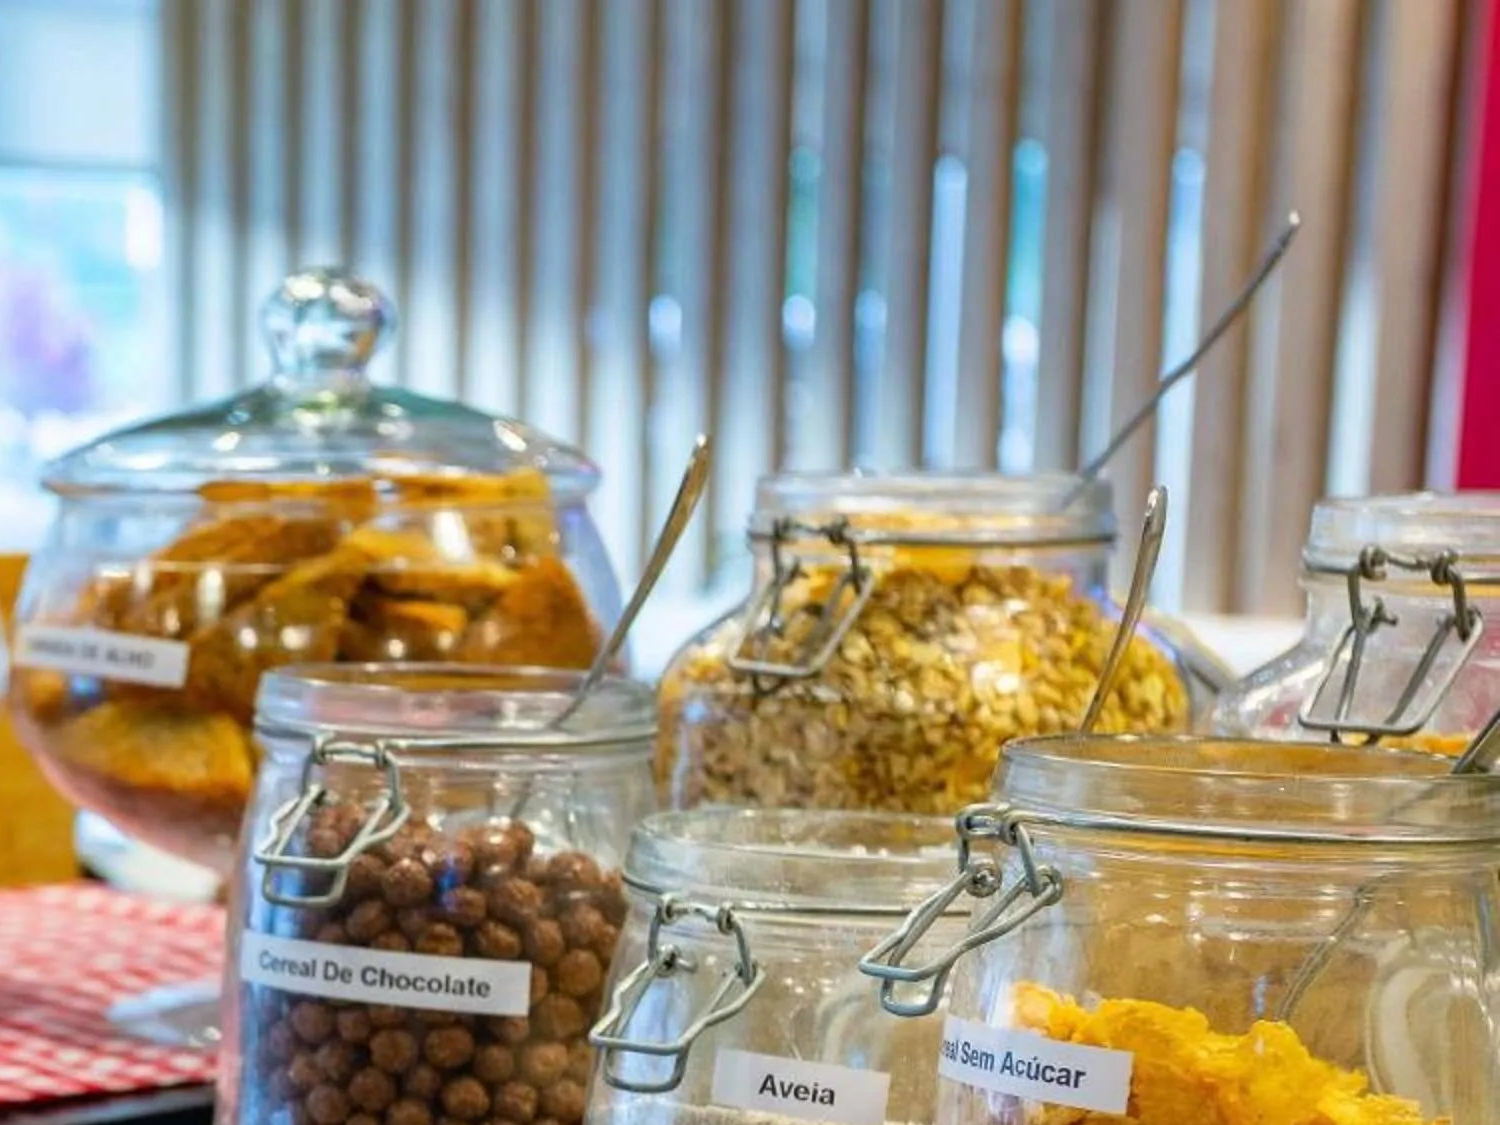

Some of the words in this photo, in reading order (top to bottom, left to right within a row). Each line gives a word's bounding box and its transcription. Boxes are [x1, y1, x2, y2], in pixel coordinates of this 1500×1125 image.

[258, 949, 318, 979] Cereal
[323, 960, 353, 985] De
[360, 965, 491, 999] Chocolate
[960, 1040, 996, 1073] Sem
[758, 1073, 836, 1107] Aveia
